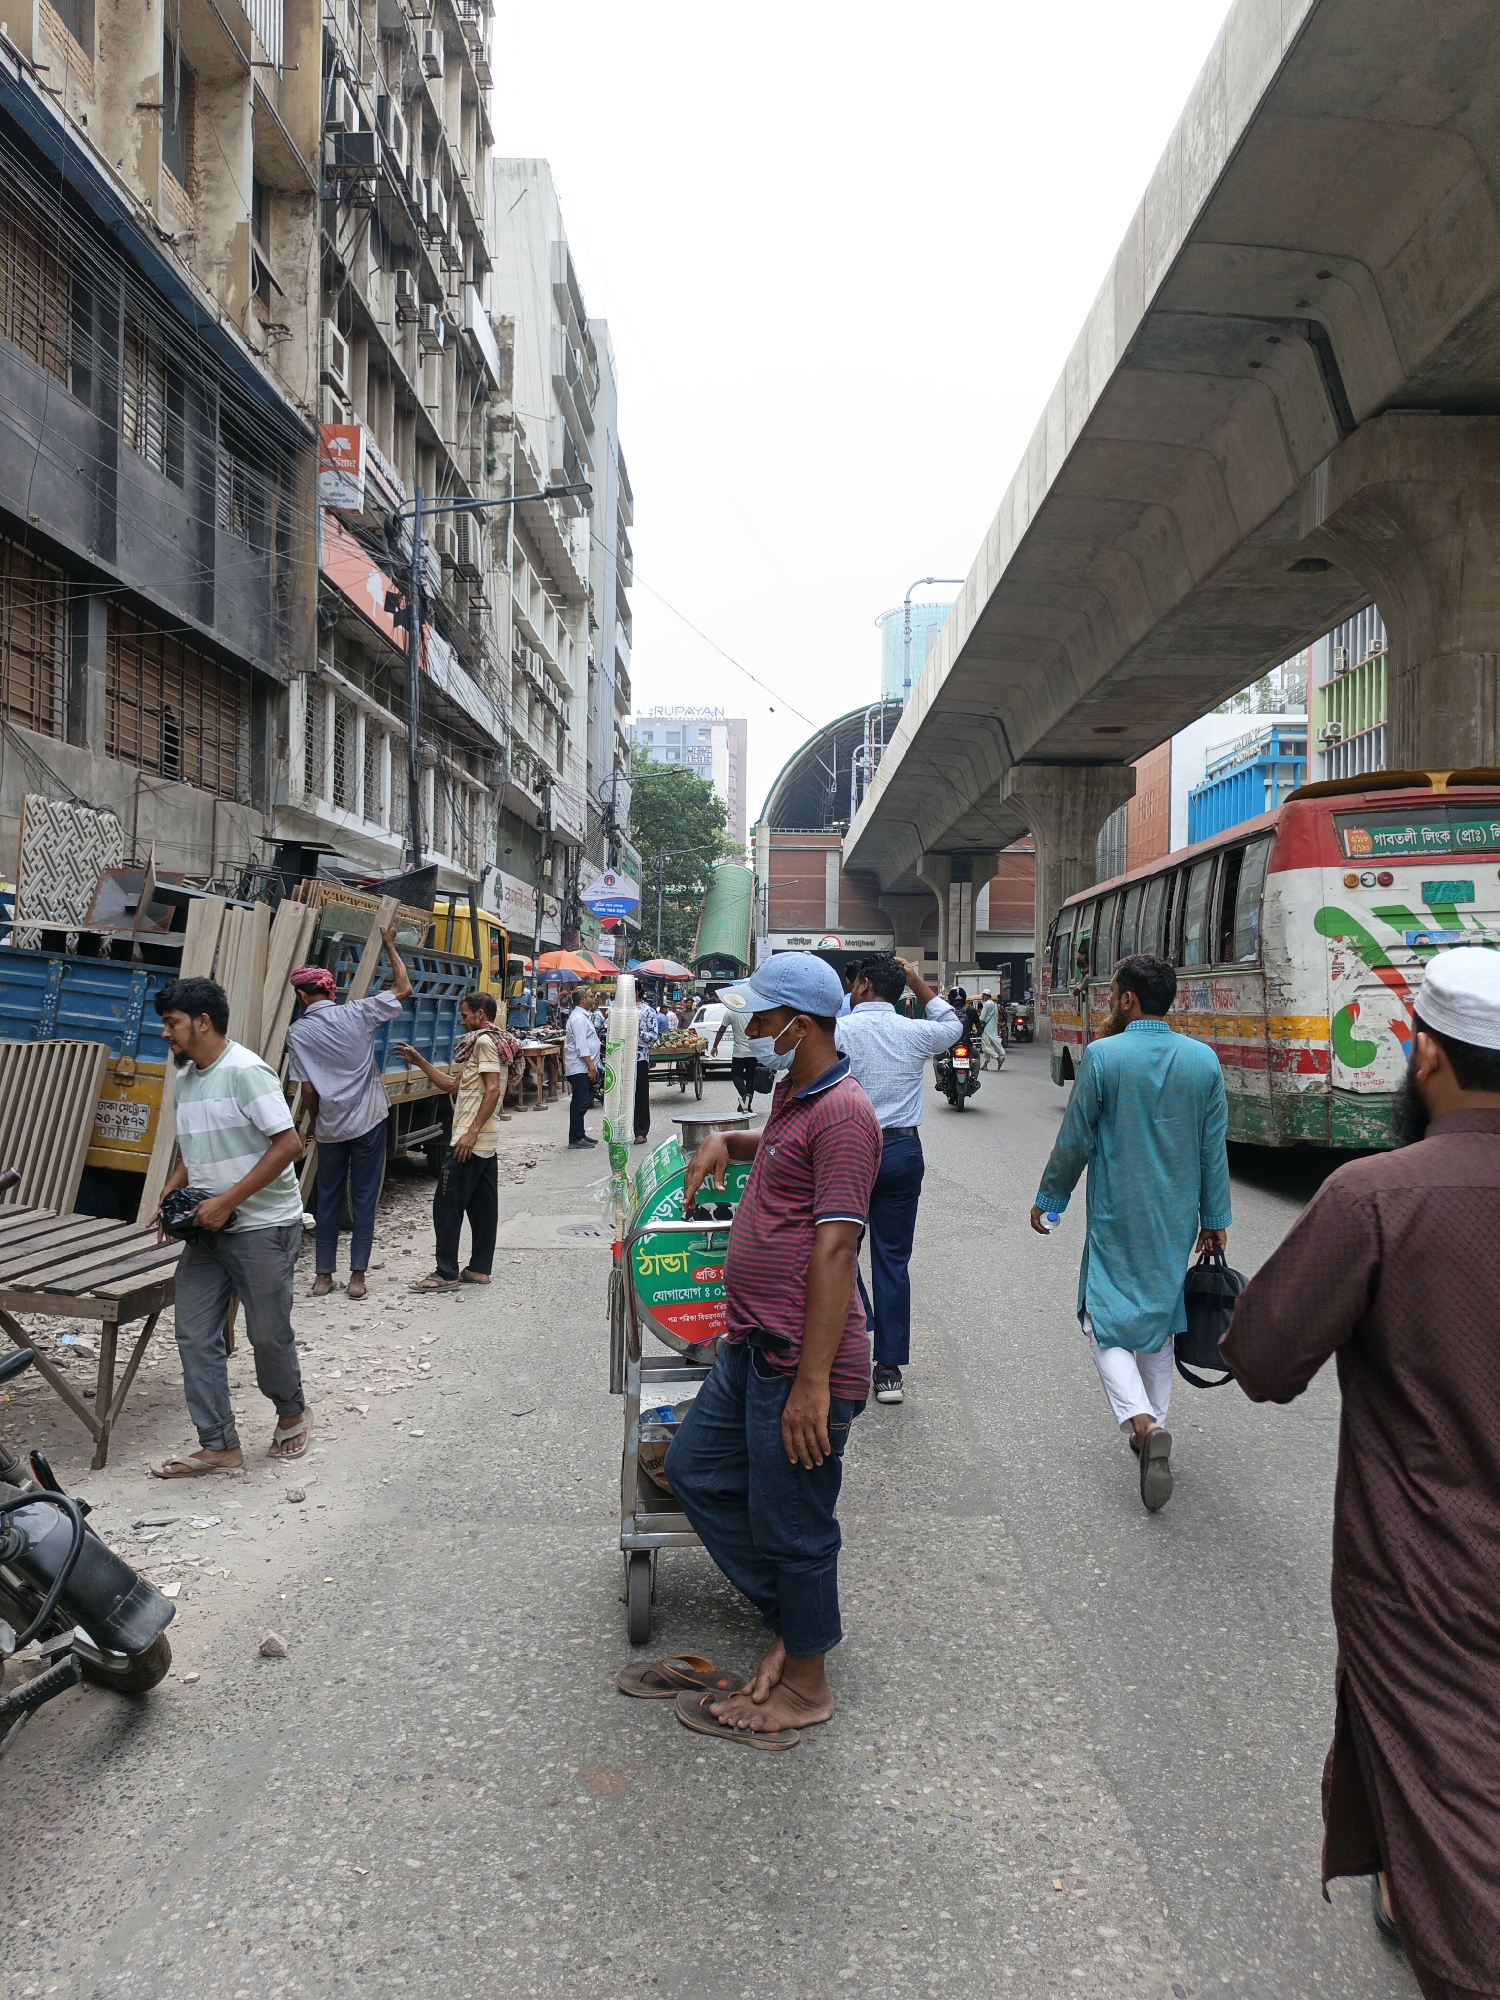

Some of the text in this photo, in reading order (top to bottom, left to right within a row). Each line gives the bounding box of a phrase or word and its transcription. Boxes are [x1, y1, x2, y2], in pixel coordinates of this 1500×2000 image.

[654, 706, 724, 717] RUPAYAN
[1373, 827, 1418, 847] গাবতলী
[1420, 827, 1451, 845] লিংক
[787, 937, 812, 946] মতিঝিল
[844, 939, 876, 948] Motijheel
[97, 1101, 118, 1111] ঢাকা
[99, 1127, 141, 1140] DRIVER
[636, 1247, 691, 1276] ঠান্ডা
[696, 1267, 717, 1281] প্রতি
[653, 1286, 702, 1302] যোগাযোগ
